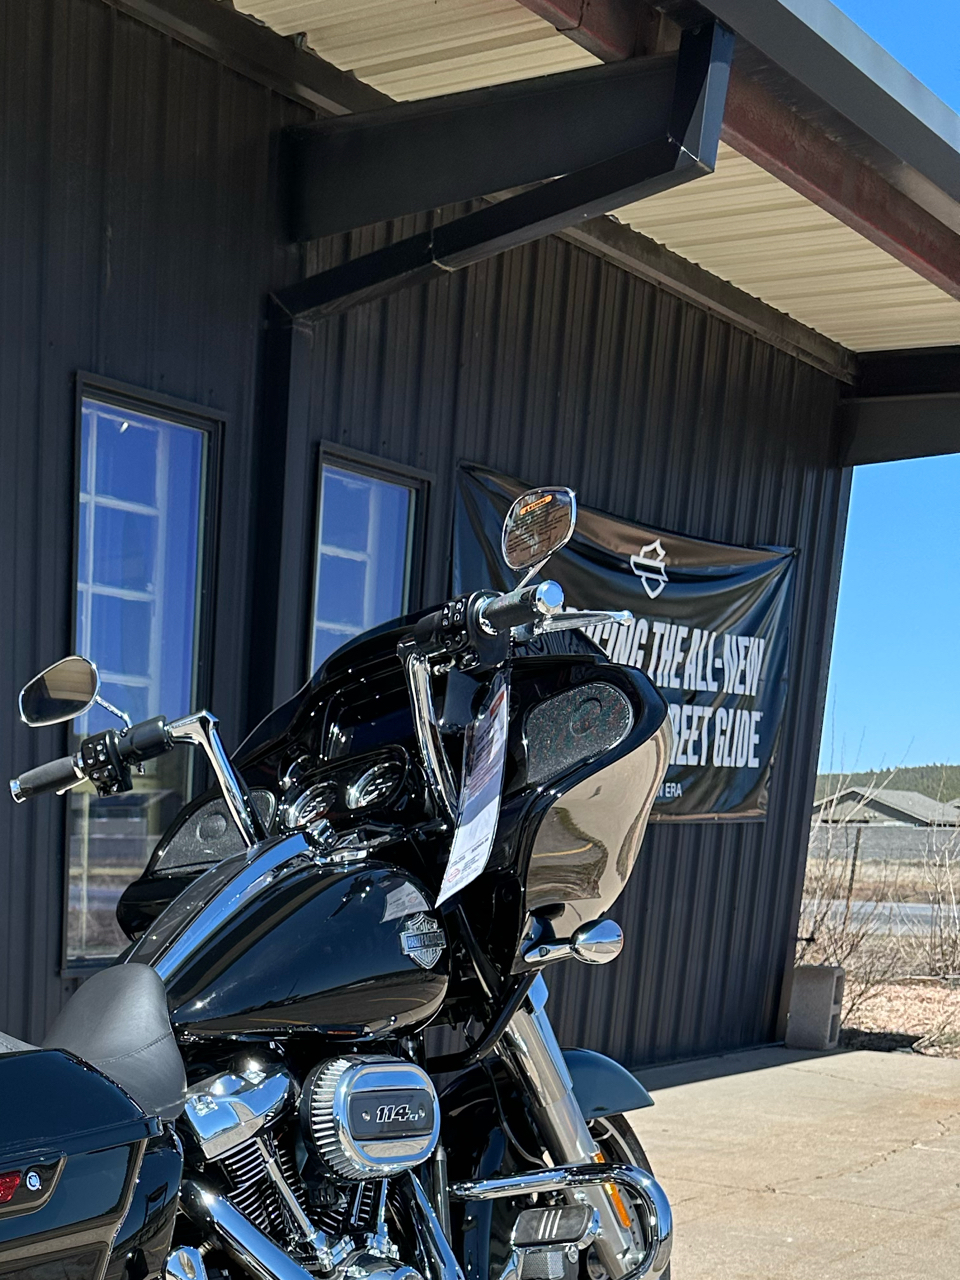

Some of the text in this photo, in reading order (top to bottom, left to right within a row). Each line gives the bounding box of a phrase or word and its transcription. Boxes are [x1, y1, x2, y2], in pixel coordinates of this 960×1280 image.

[647, 621, 689, 688] THE
[683, 627, 765, 696] ALL-NEW
[665, 783, 683, 797] ERA
[376, 1104, 411, 1123] 114
